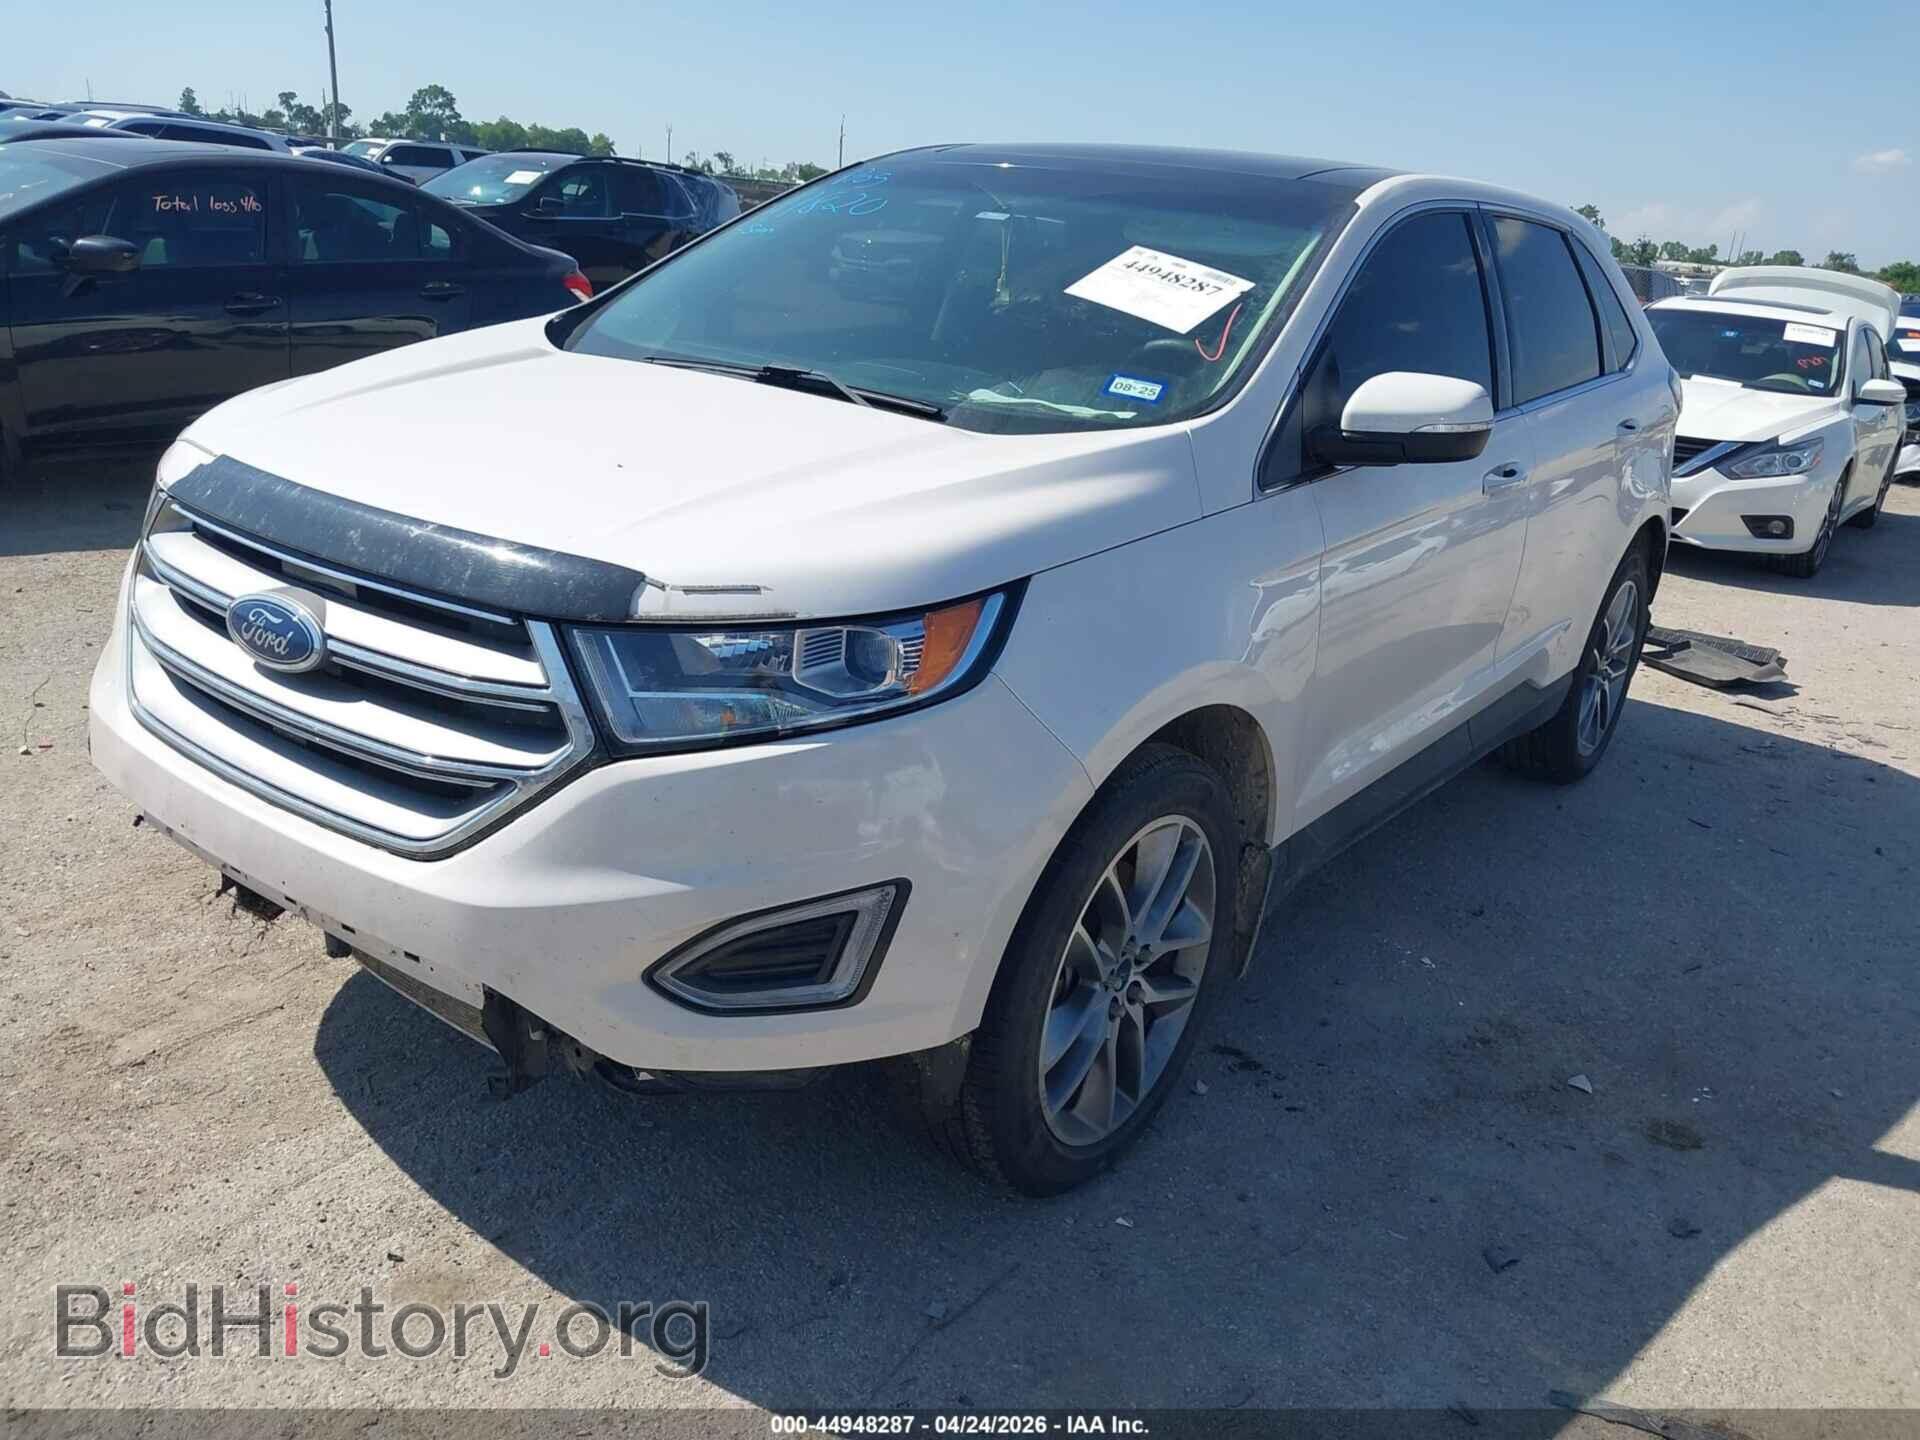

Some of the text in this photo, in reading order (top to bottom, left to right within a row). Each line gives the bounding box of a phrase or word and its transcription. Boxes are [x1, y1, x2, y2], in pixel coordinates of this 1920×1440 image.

[152, 195, 199, 212] Total
[210, 195, 238, 213] loss
[1122, 261, 1223, 296] 44948287
[241, 608, 294, 655] Ford
